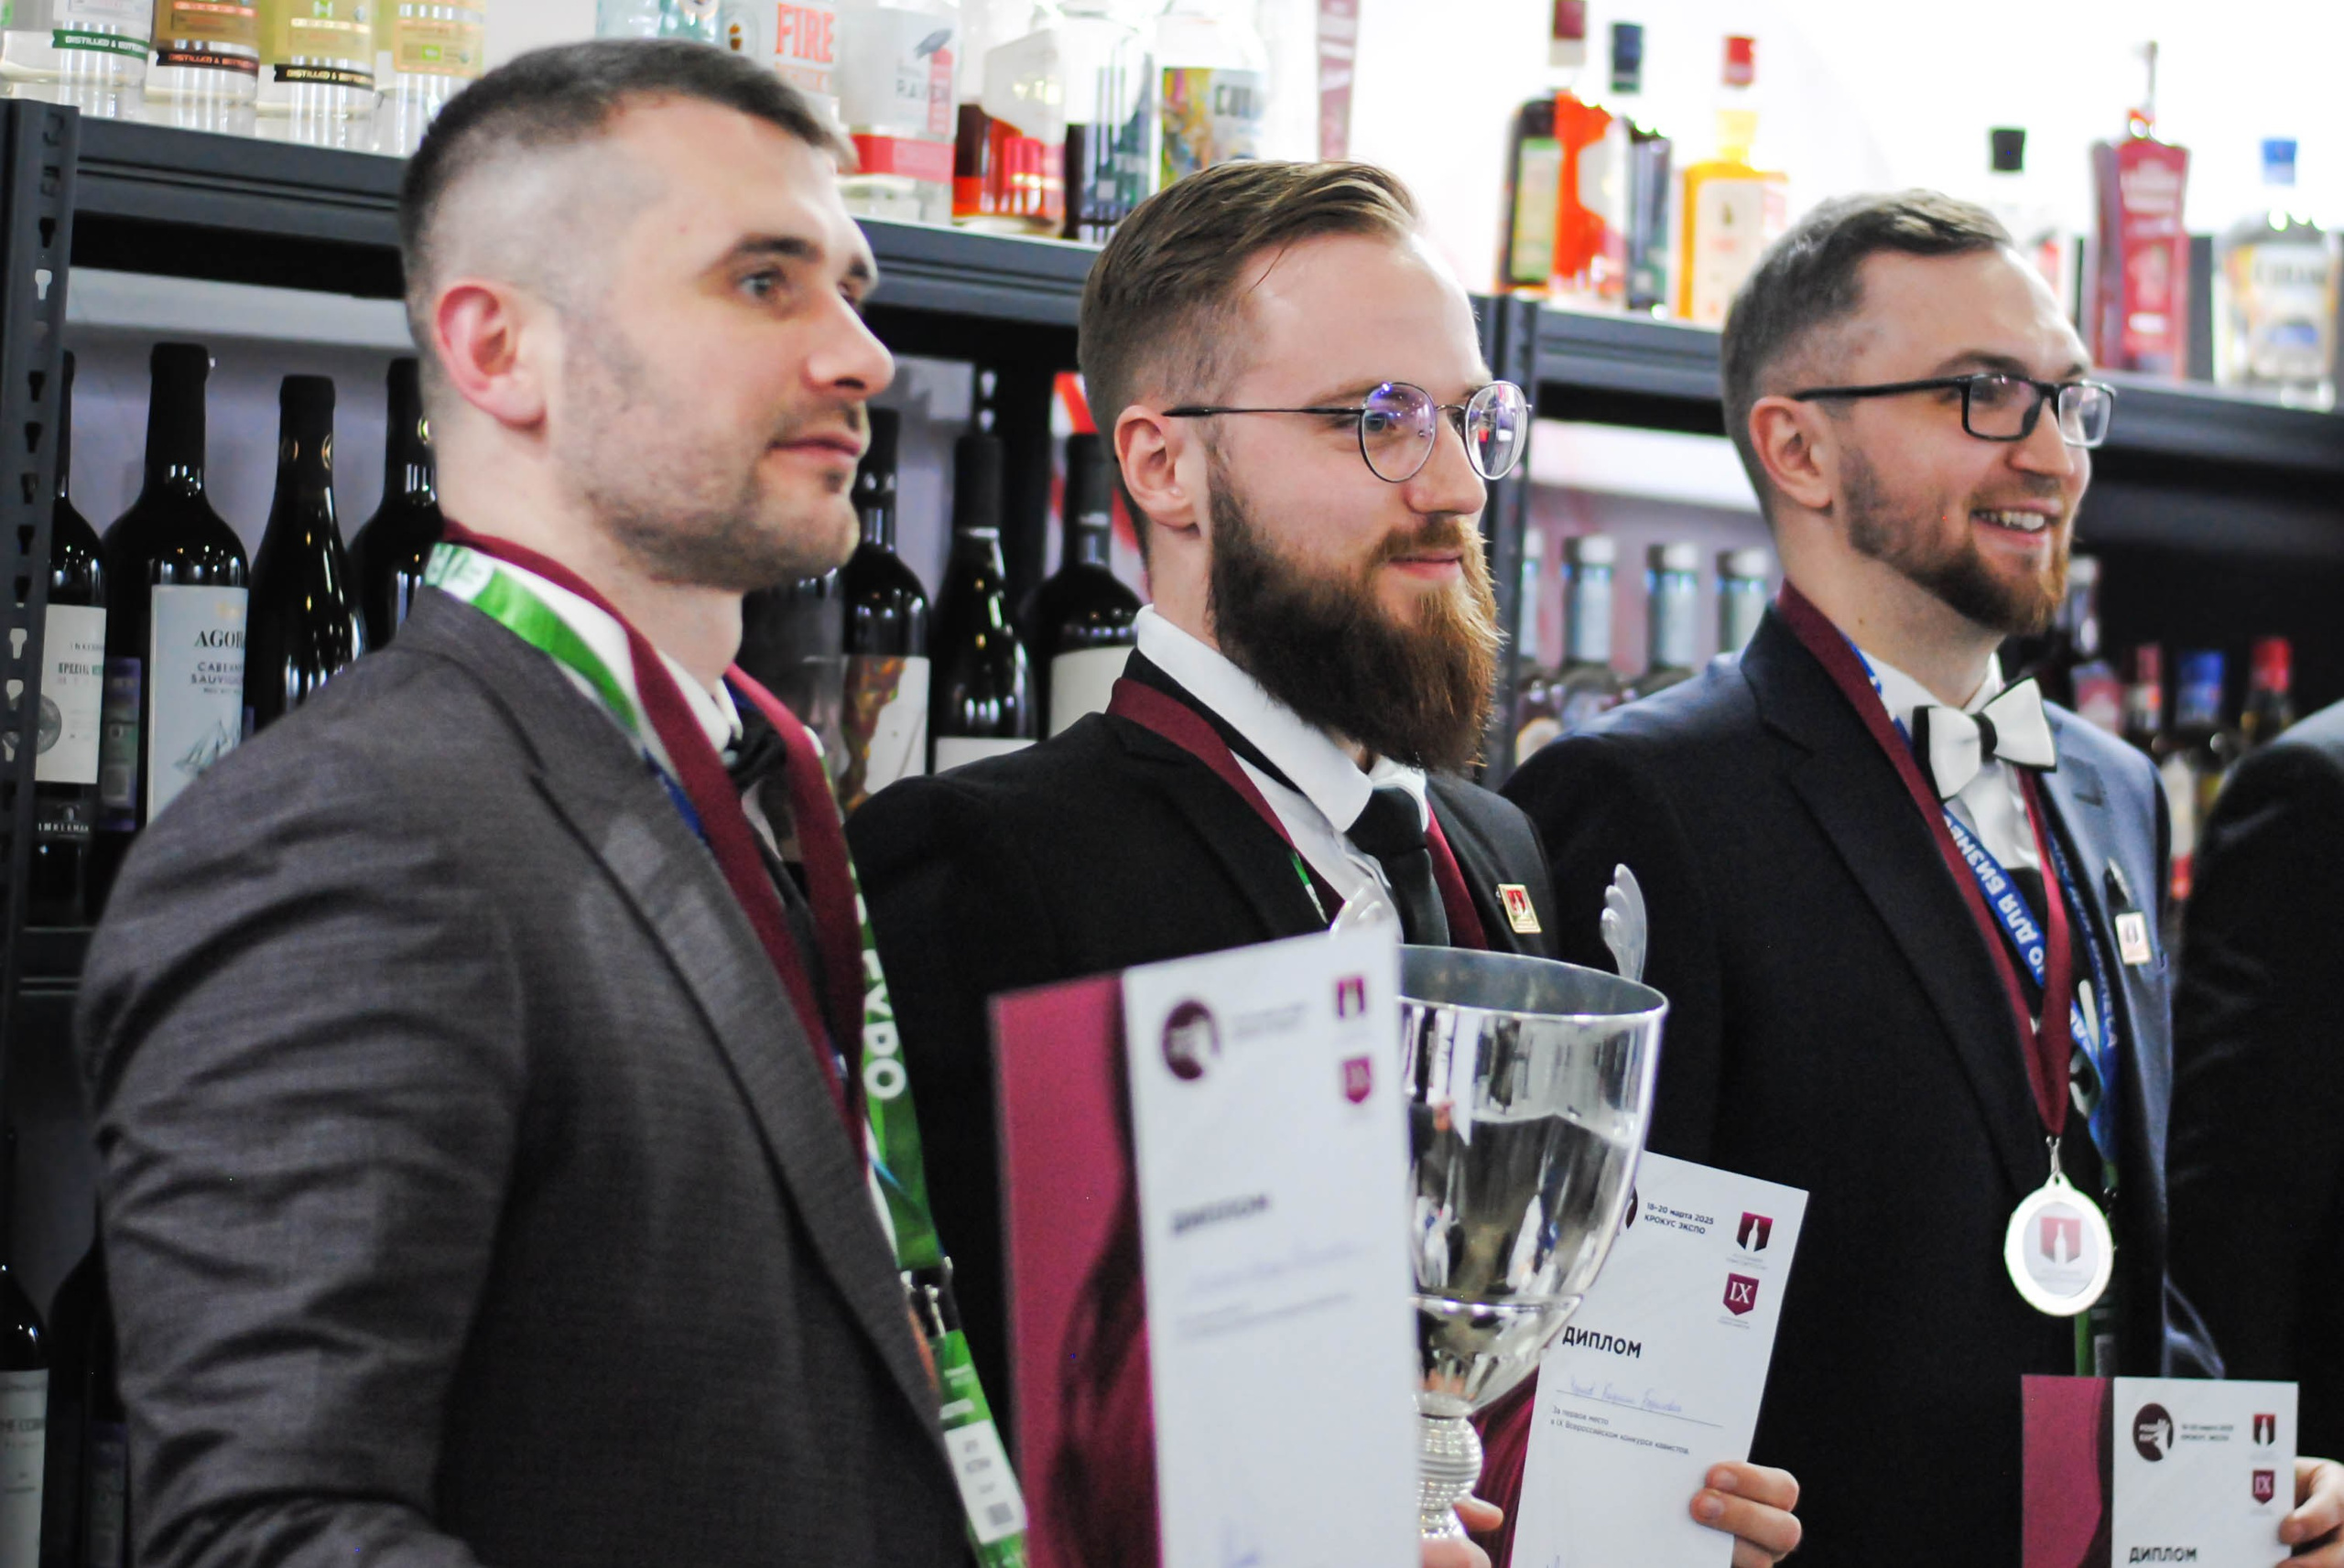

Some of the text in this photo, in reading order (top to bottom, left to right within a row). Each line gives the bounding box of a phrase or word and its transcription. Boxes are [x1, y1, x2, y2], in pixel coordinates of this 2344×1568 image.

[776, 4, 835, 62] FIRE
[1997, 893, 2039, 946] ДЛЯ
[1644, 1214, 1706, 1235] КРОКУС ЭКСПО
[1670, 1209, 1692, 1220] марта
[1695, 1214, 1714, 1225] 2025
[1730, 1281, 1753, 1304] IX
[1562, 1325, 1642, 1358] ДИПЛОМ
[2129, 1546, 2197, 1563] ДИПЛОМ
